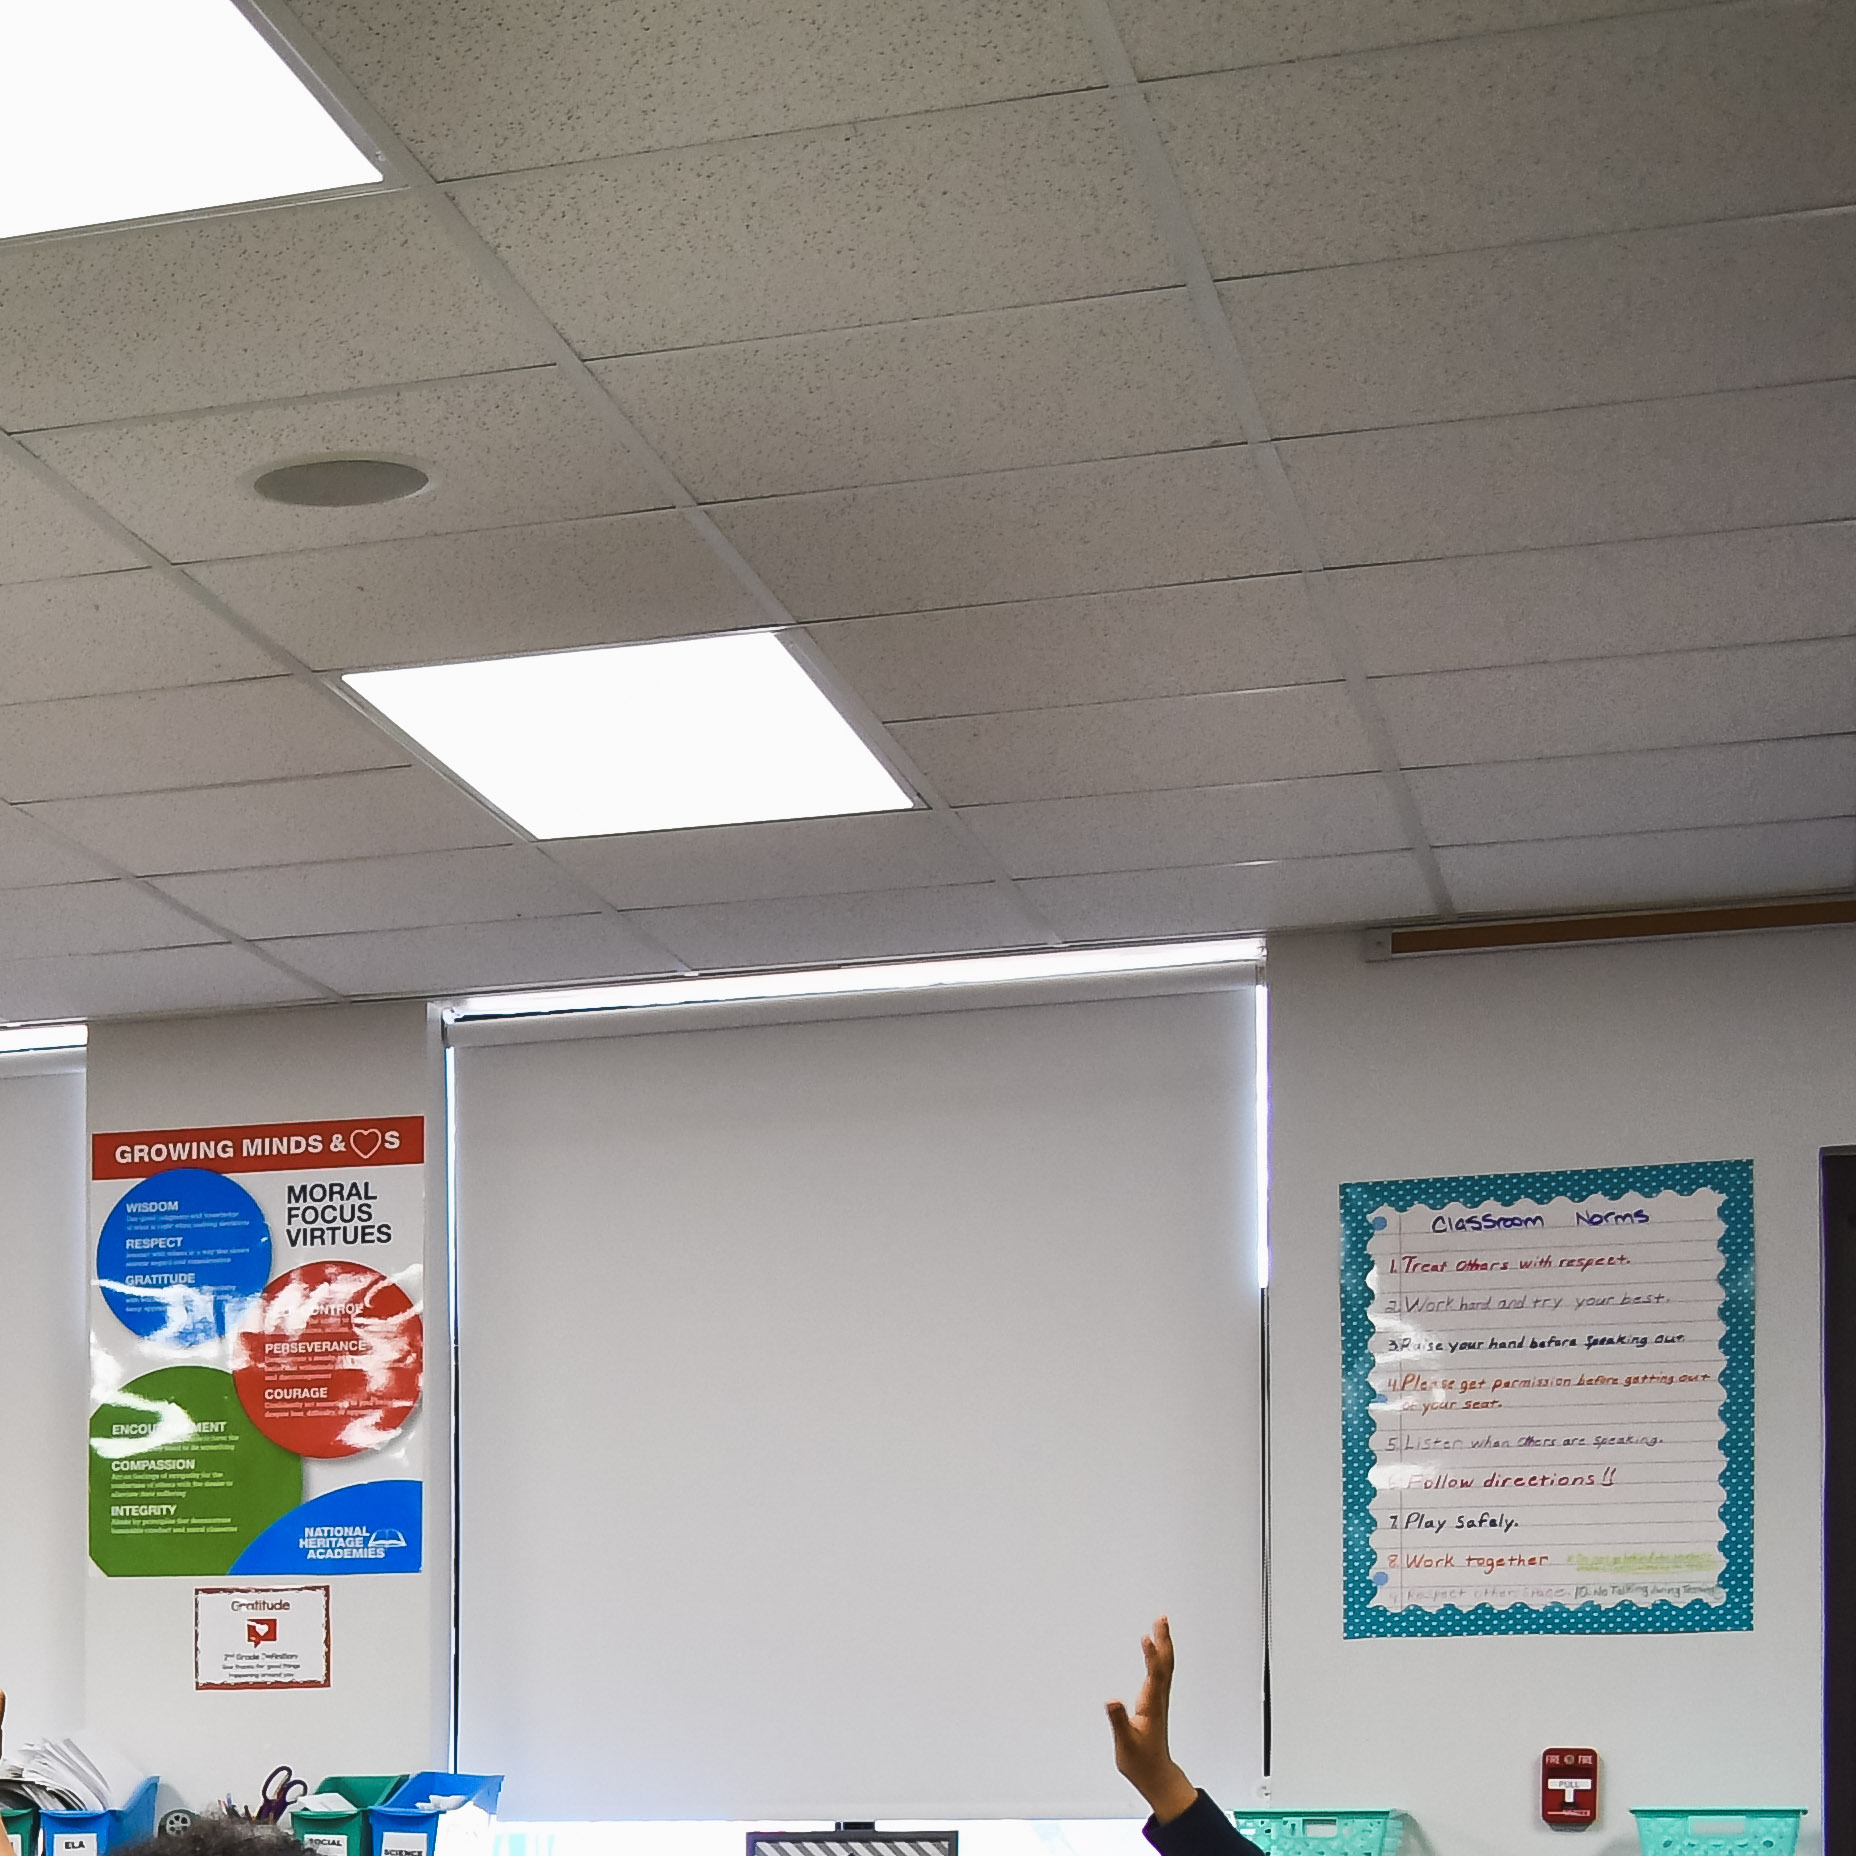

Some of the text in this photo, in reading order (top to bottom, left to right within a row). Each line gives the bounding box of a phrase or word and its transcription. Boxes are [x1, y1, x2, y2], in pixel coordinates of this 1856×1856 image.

[115, 1140, 234, 1163] GROWING
[242, 1135, 323, 1157] MINDS
[330, 1134, 347, 1151] &
[287, 1181, 378, 1204] MORAL
[126, 1201, 179, 1212] WISDOM
[287, 1203, 373, 1225] FOCUS
[1432, 1209, 1650, 1233] Classroom Norms
[126, 1237, 183, 1249] RESPECT
[286, 1224, 392, 1248] VIRTUES
[1402, 1254, 1631, 1273] Treat with respect.
[125, 1273, 196, 1285] GRATITUDE
[1406, 1295, 1615, 1313] Work hard and try your
[265, 1340, 367, 1354] PERSEVERANCE
[1448, 1336, 1577, 1353] your hand before
[1458, 1379, 1486, 1394] get
[1492, 1376, 1571, 1392] permission
[1576, 1373, 1619, 1386] before
[1679, 1374, 1710, 1383] out
[265, 1387, 328, 1399] COURAGE
[1422, 1400, 1503, 1416] your seat.
[1405, 1434, 1586, 1450] Listen when are
[111, 1459, 195, 1471] COMPASSION
[1407, 1473, 1476, 1490] Follow
[111, 1504, 177, 1516] INTEGRITY
[1404, 1512, 1446, 1534] Play
[304, 1526, 370, 1538] NATIONAL
[299, 1537, 363, 1548] HERITAGE
[307, 1548, 385, 1559] ACADEMIES
[1406, 1553, 1455, 1568] Work
[1465, 1553, 1549, 1575] together
[231, 1600, 290, 1612] Gratitude
[1558, 1780, 1580, 1788] PULL
[64, 1841, 85, 1849] ELA
